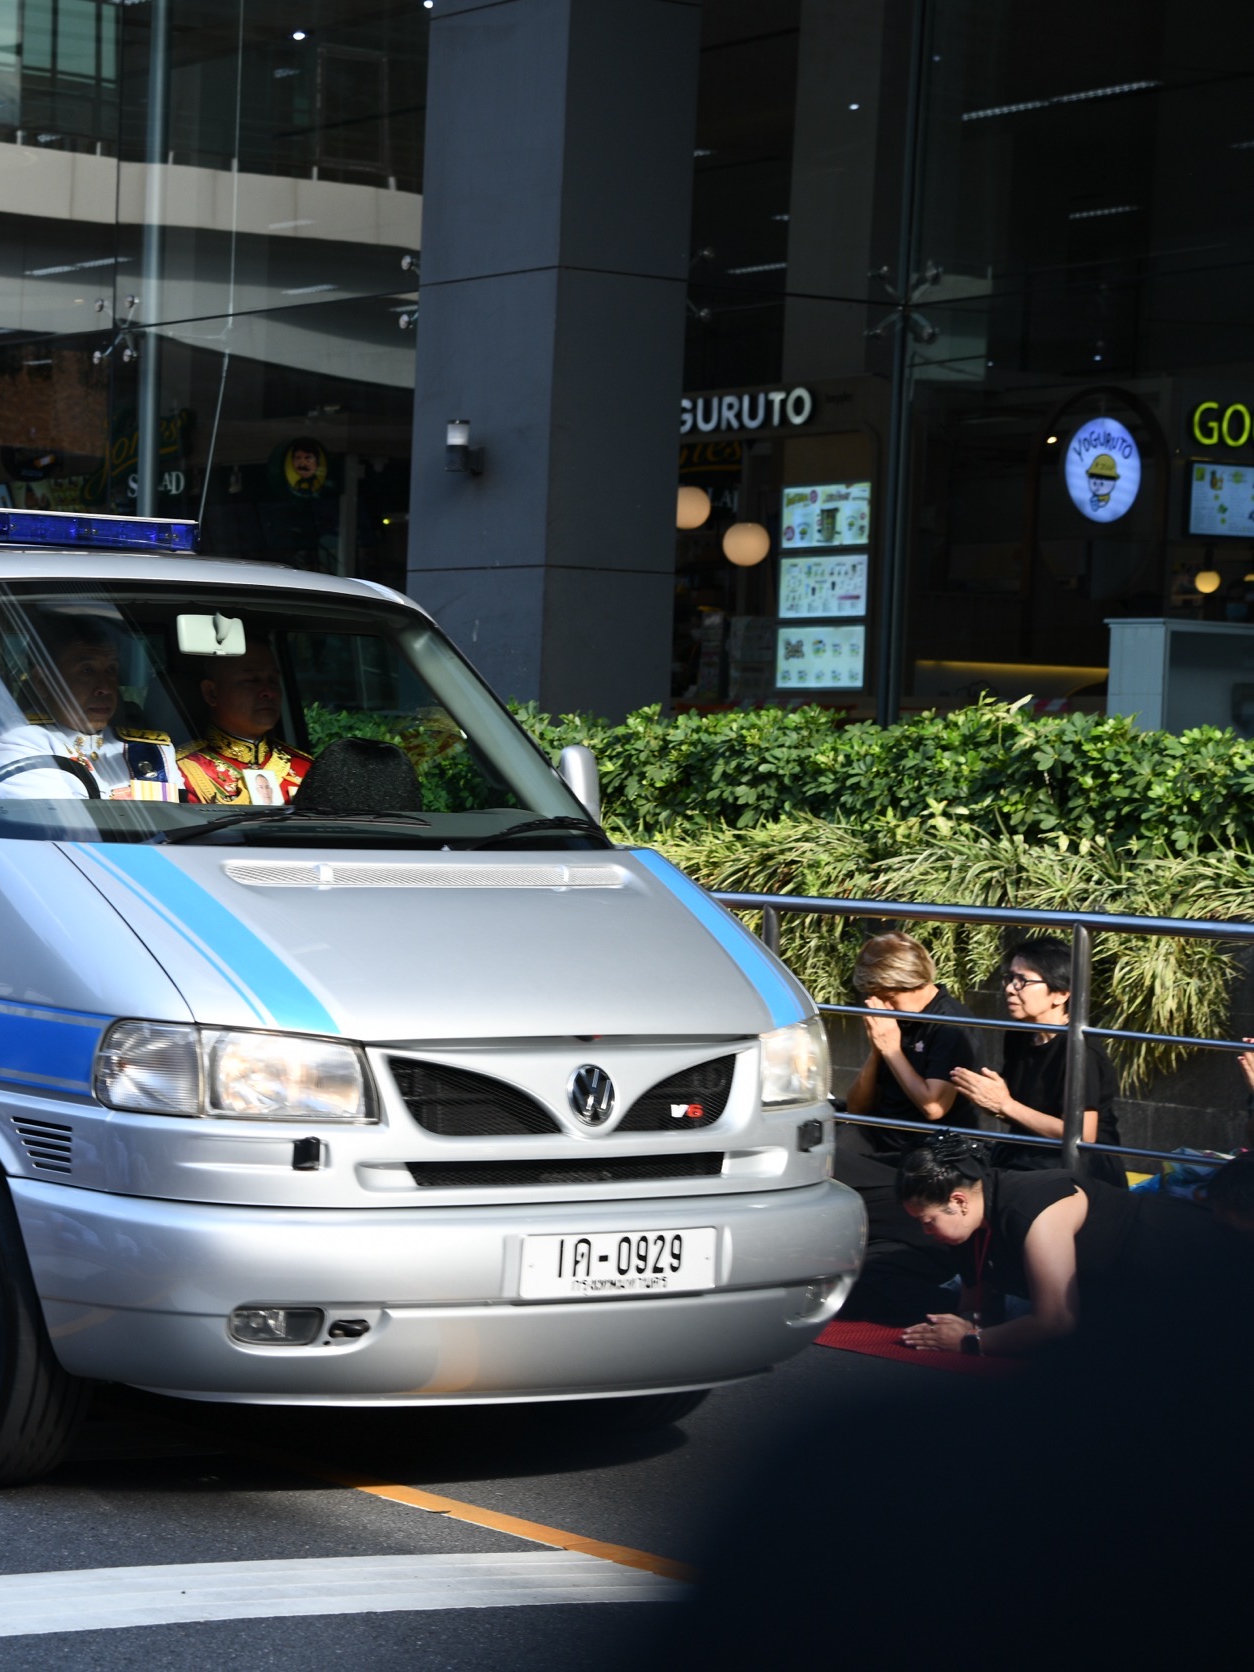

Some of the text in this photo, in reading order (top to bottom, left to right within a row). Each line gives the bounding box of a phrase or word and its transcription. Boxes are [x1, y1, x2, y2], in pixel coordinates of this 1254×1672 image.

[1193, 401, 1254, 447] GO
[1073, 431, 1133, 462] YOGURUTO
[670, 1104, 703, 1118] V6
